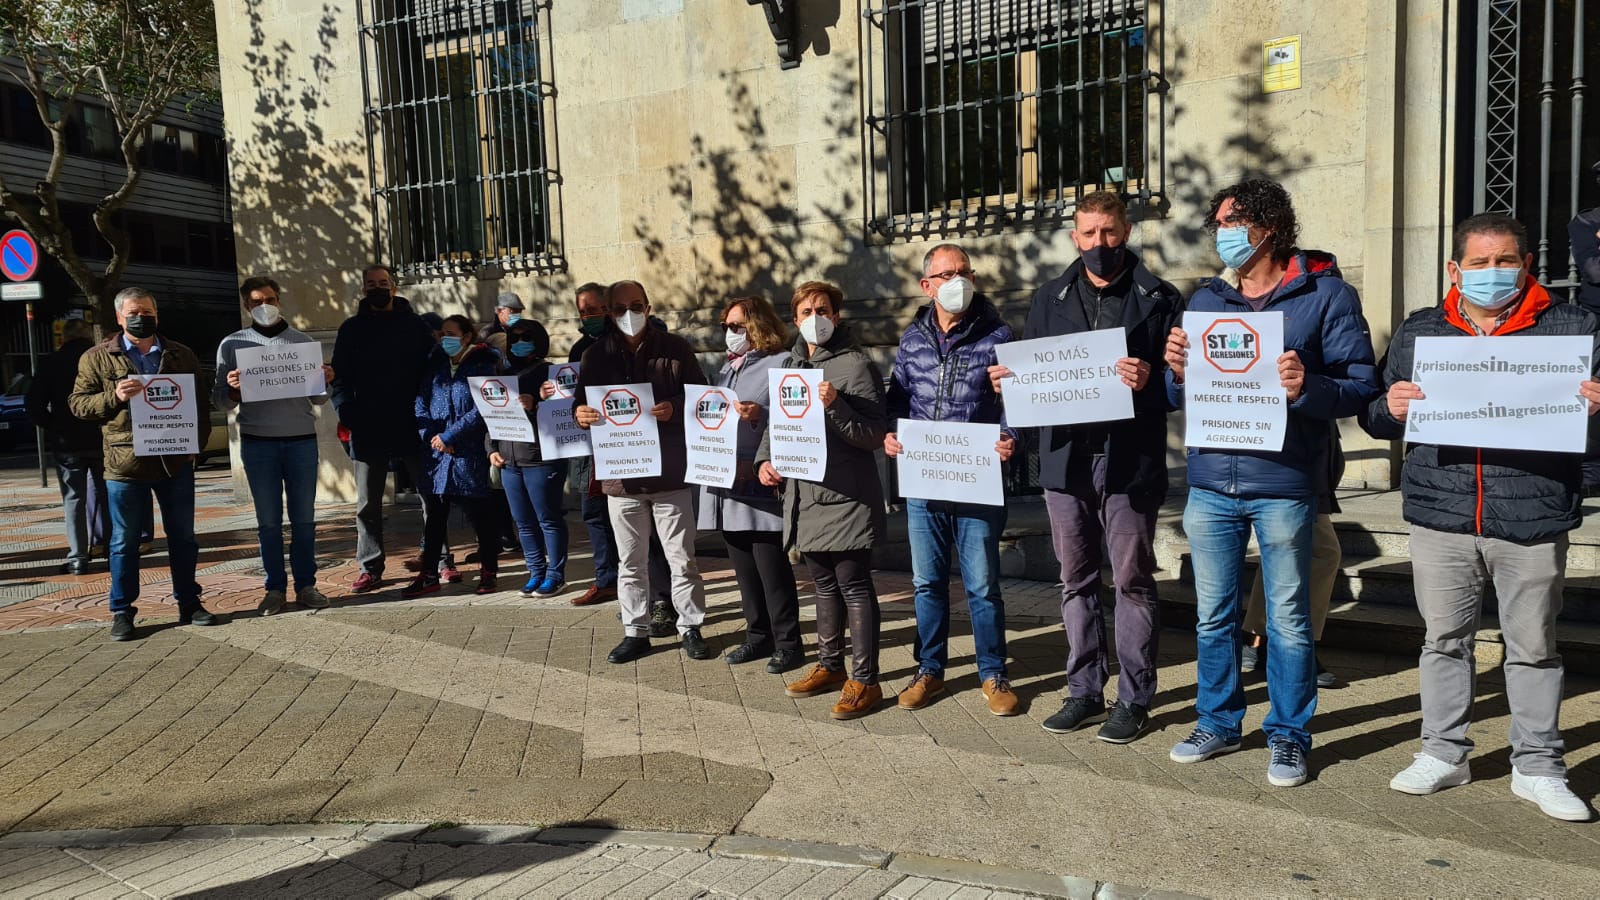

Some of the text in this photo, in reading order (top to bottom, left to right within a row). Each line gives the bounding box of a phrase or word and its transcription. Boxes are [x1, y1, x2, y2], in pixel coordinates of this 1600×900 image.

[261, 353, 275, 361] NO
[1034, 345, 1089, 363] NO MÁS
[1210, 350, 1255, 359] AGRESIONES
[245, 362, 316, 376] AGRESIONES EN
[260, 375, 306, 387] PRISIONES
[1012, 365, 1117, 386] AGRESIONES EN
[1211, 380, 1262, 390] PRISIONES
[1031, 387, 1101, 404] PRISIONES
[1194, 393, 1280, 405] MERECE RESPETO
[1202, 419, 1271, 430] PRISIONES SIN
[556, 434, 587, 444] RESPETO
[598, 441, 625, 449] MERECE
[925, 433, 970, 447] NO MÁS
[1206, 434, 1264, 445] AGRESIONES
[905, 450, 991, 466] AGRESIONES EN
[609, 467, 649, 476] AGRESIONES
[921, 468, 977, 483] PRISIONES
